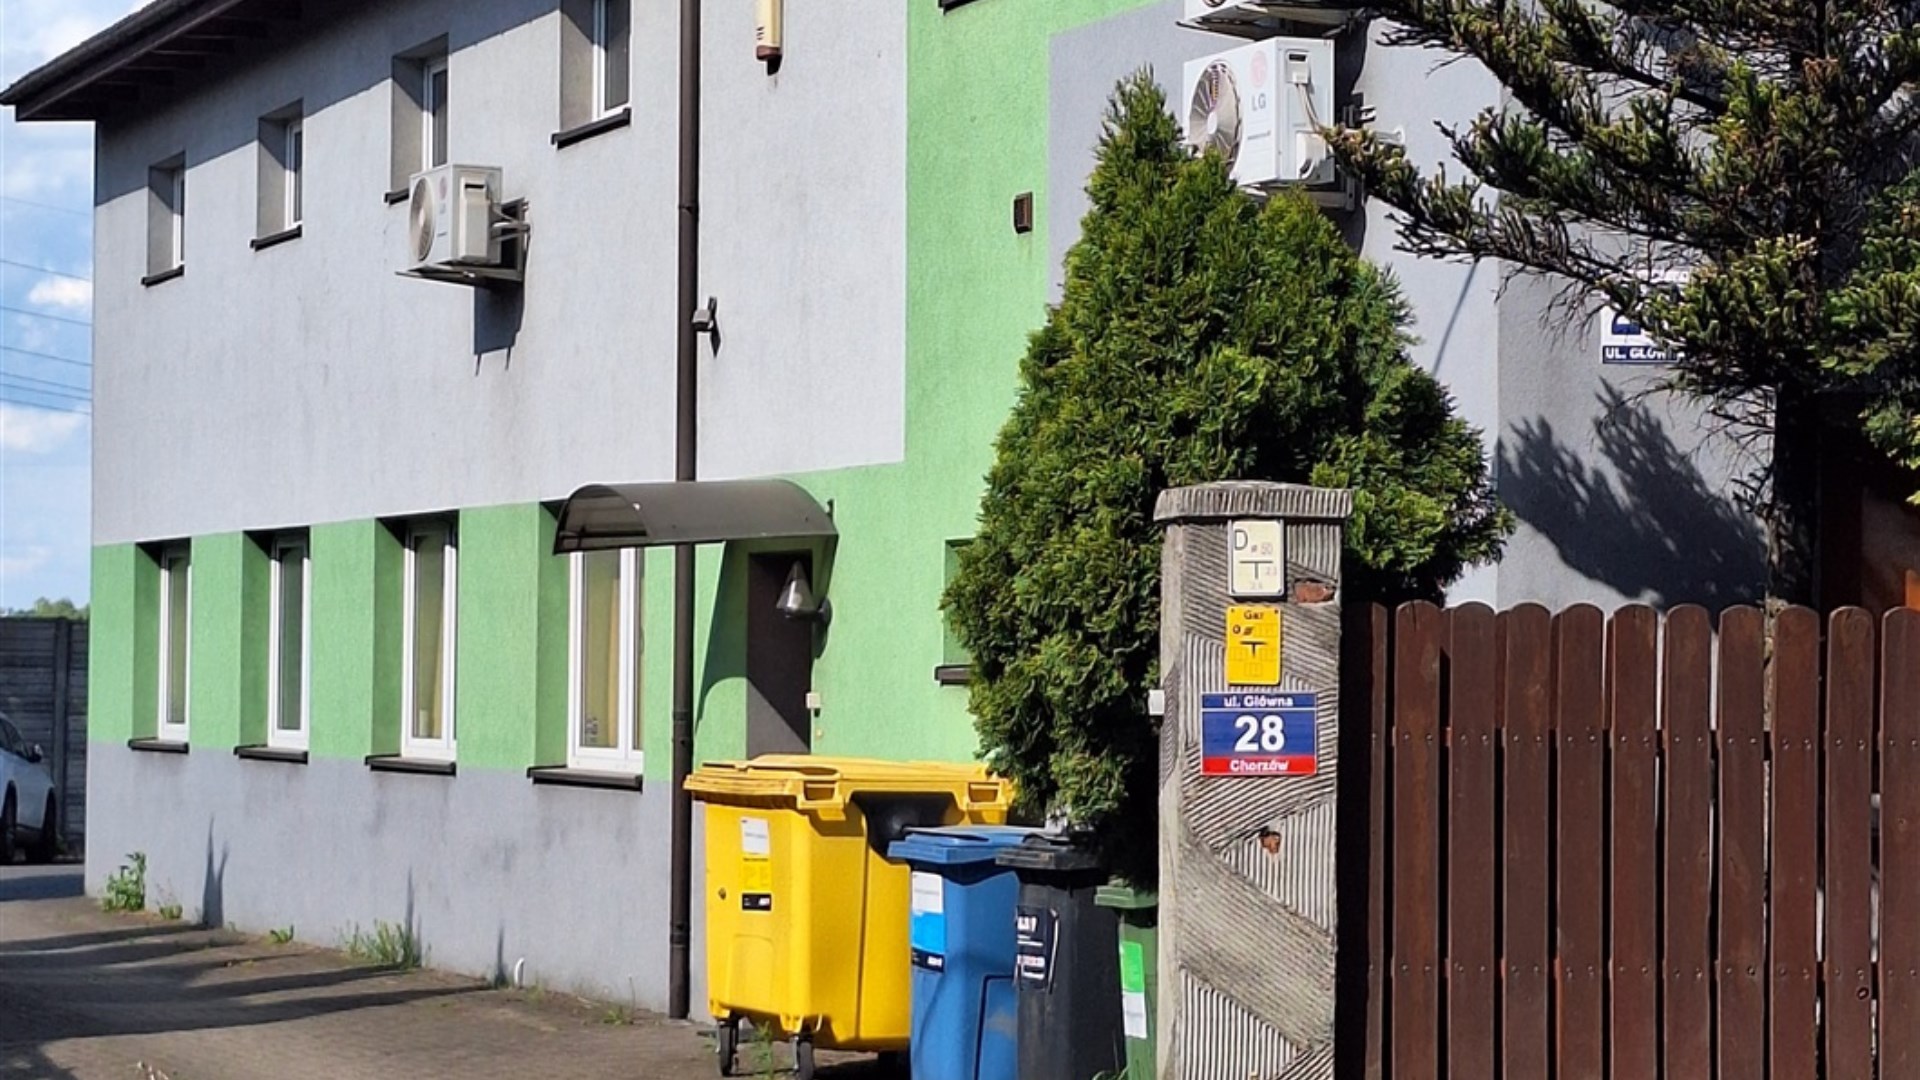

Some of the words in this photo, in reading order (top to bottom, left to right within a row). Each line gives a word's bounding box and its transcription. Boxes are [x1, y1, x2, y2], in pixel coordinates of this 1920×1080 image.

[1252, 93, 1266, 111] LG
[1234, 529, 1248, 550] D
[1224, 696, 1240, 707] ul.
[1243, 695, 1294, 707] Główna
[1234, 715, 1285, 752] 28
[1230, 759, 1289, 772] Chorzów
